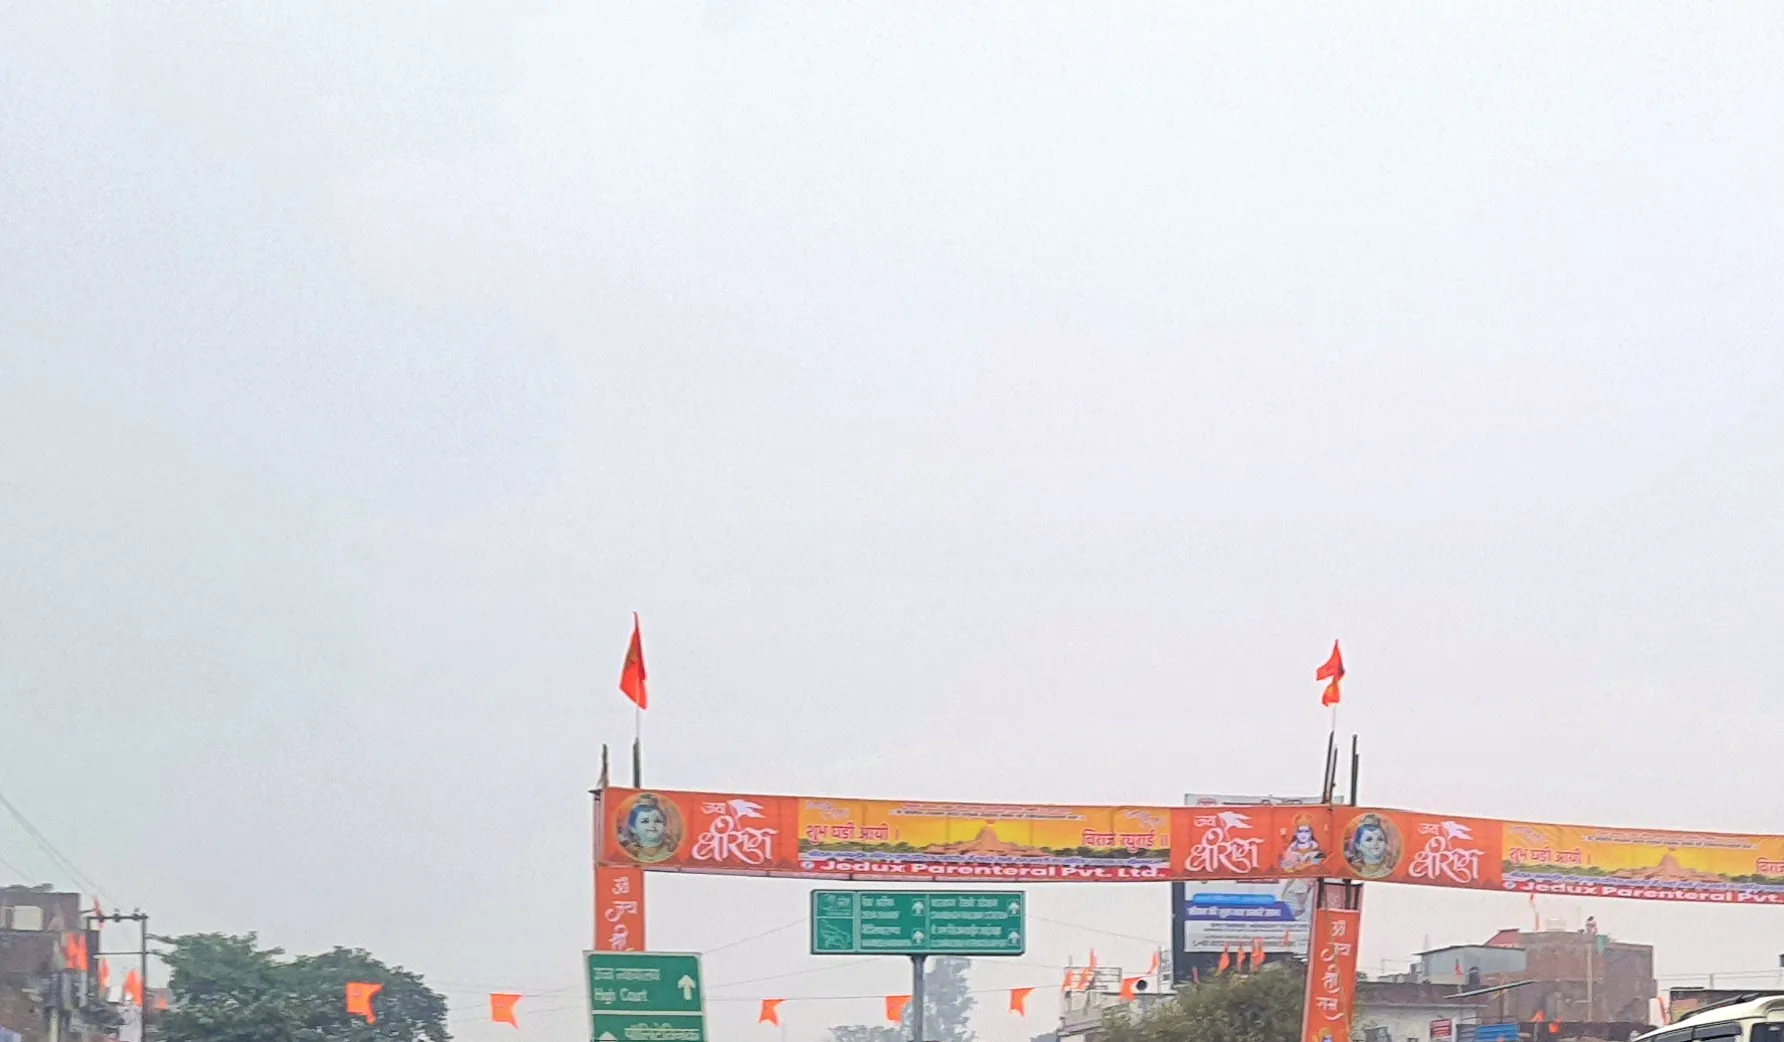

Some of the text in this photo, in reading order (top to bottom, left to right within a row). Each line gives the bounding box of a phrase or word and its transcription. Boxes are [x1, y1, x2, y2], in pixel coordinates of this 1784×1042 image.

[820, 860, 1166, 878] Jedux Parenteral Pvt. Ltd.
[1520, 881, 1599, 895] Jedux
[1602, 886, 1733, 901] Parenteral
[1737, 891, 1784, 903] Pvt.
[619, 988, 648, 1002] Court
